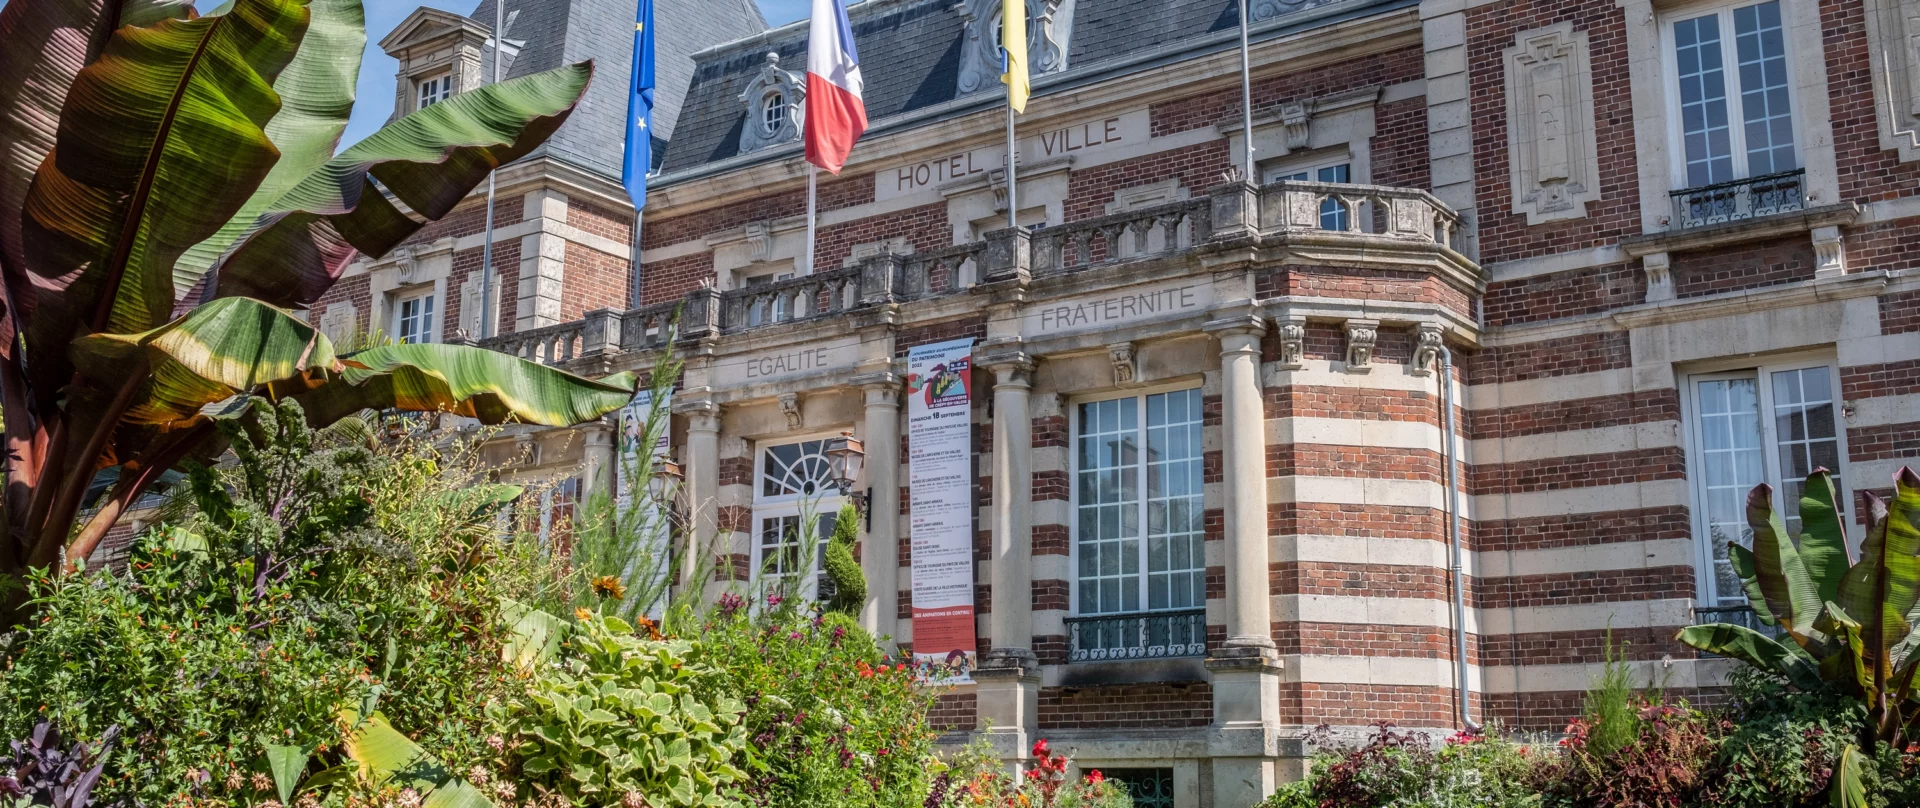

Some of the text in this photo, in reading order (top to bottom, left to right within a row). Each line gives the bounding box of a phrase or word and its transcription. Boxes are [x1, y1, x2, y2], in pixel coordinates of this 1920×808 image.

[898, 152, 984, 191] HOTEL
[1041, 117, 1122, 156] VILLE
[1041, 285, 1195, 330] FRATERNITE
[747, 347, 827, 378] EGALITE
[919, 353, 945, 361] PATRIMOINE
